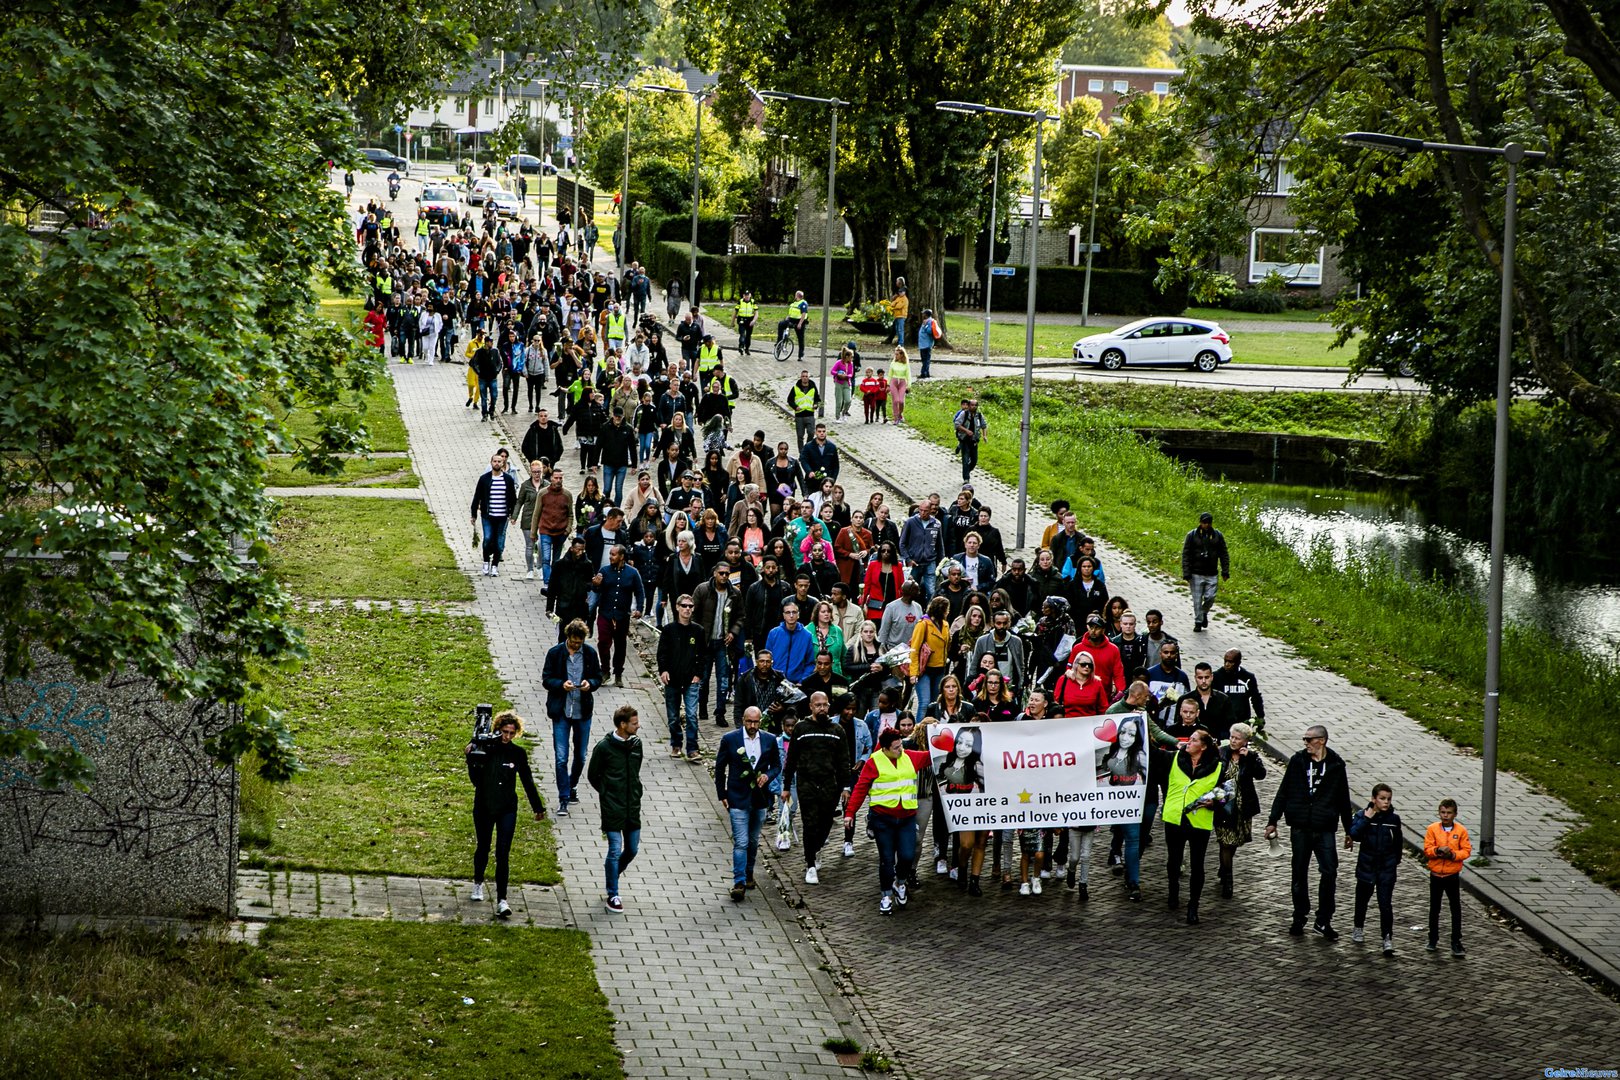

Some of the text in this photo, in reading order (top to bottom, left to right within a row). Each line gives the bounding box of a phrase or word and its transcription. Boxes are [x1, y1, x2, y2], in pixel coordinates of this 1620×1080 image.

[1003, 750, 1077, 770] Mama
[946, 789, 1141, 811] you are a in heaven now.
[973, 812, 997, 825] mis
[1000, 810, 1026, 823] and
[1030, 810, 1058, 823] love
[1061, 810, 1087, 823] you
[1090, 807, 1142, 820] forever.
